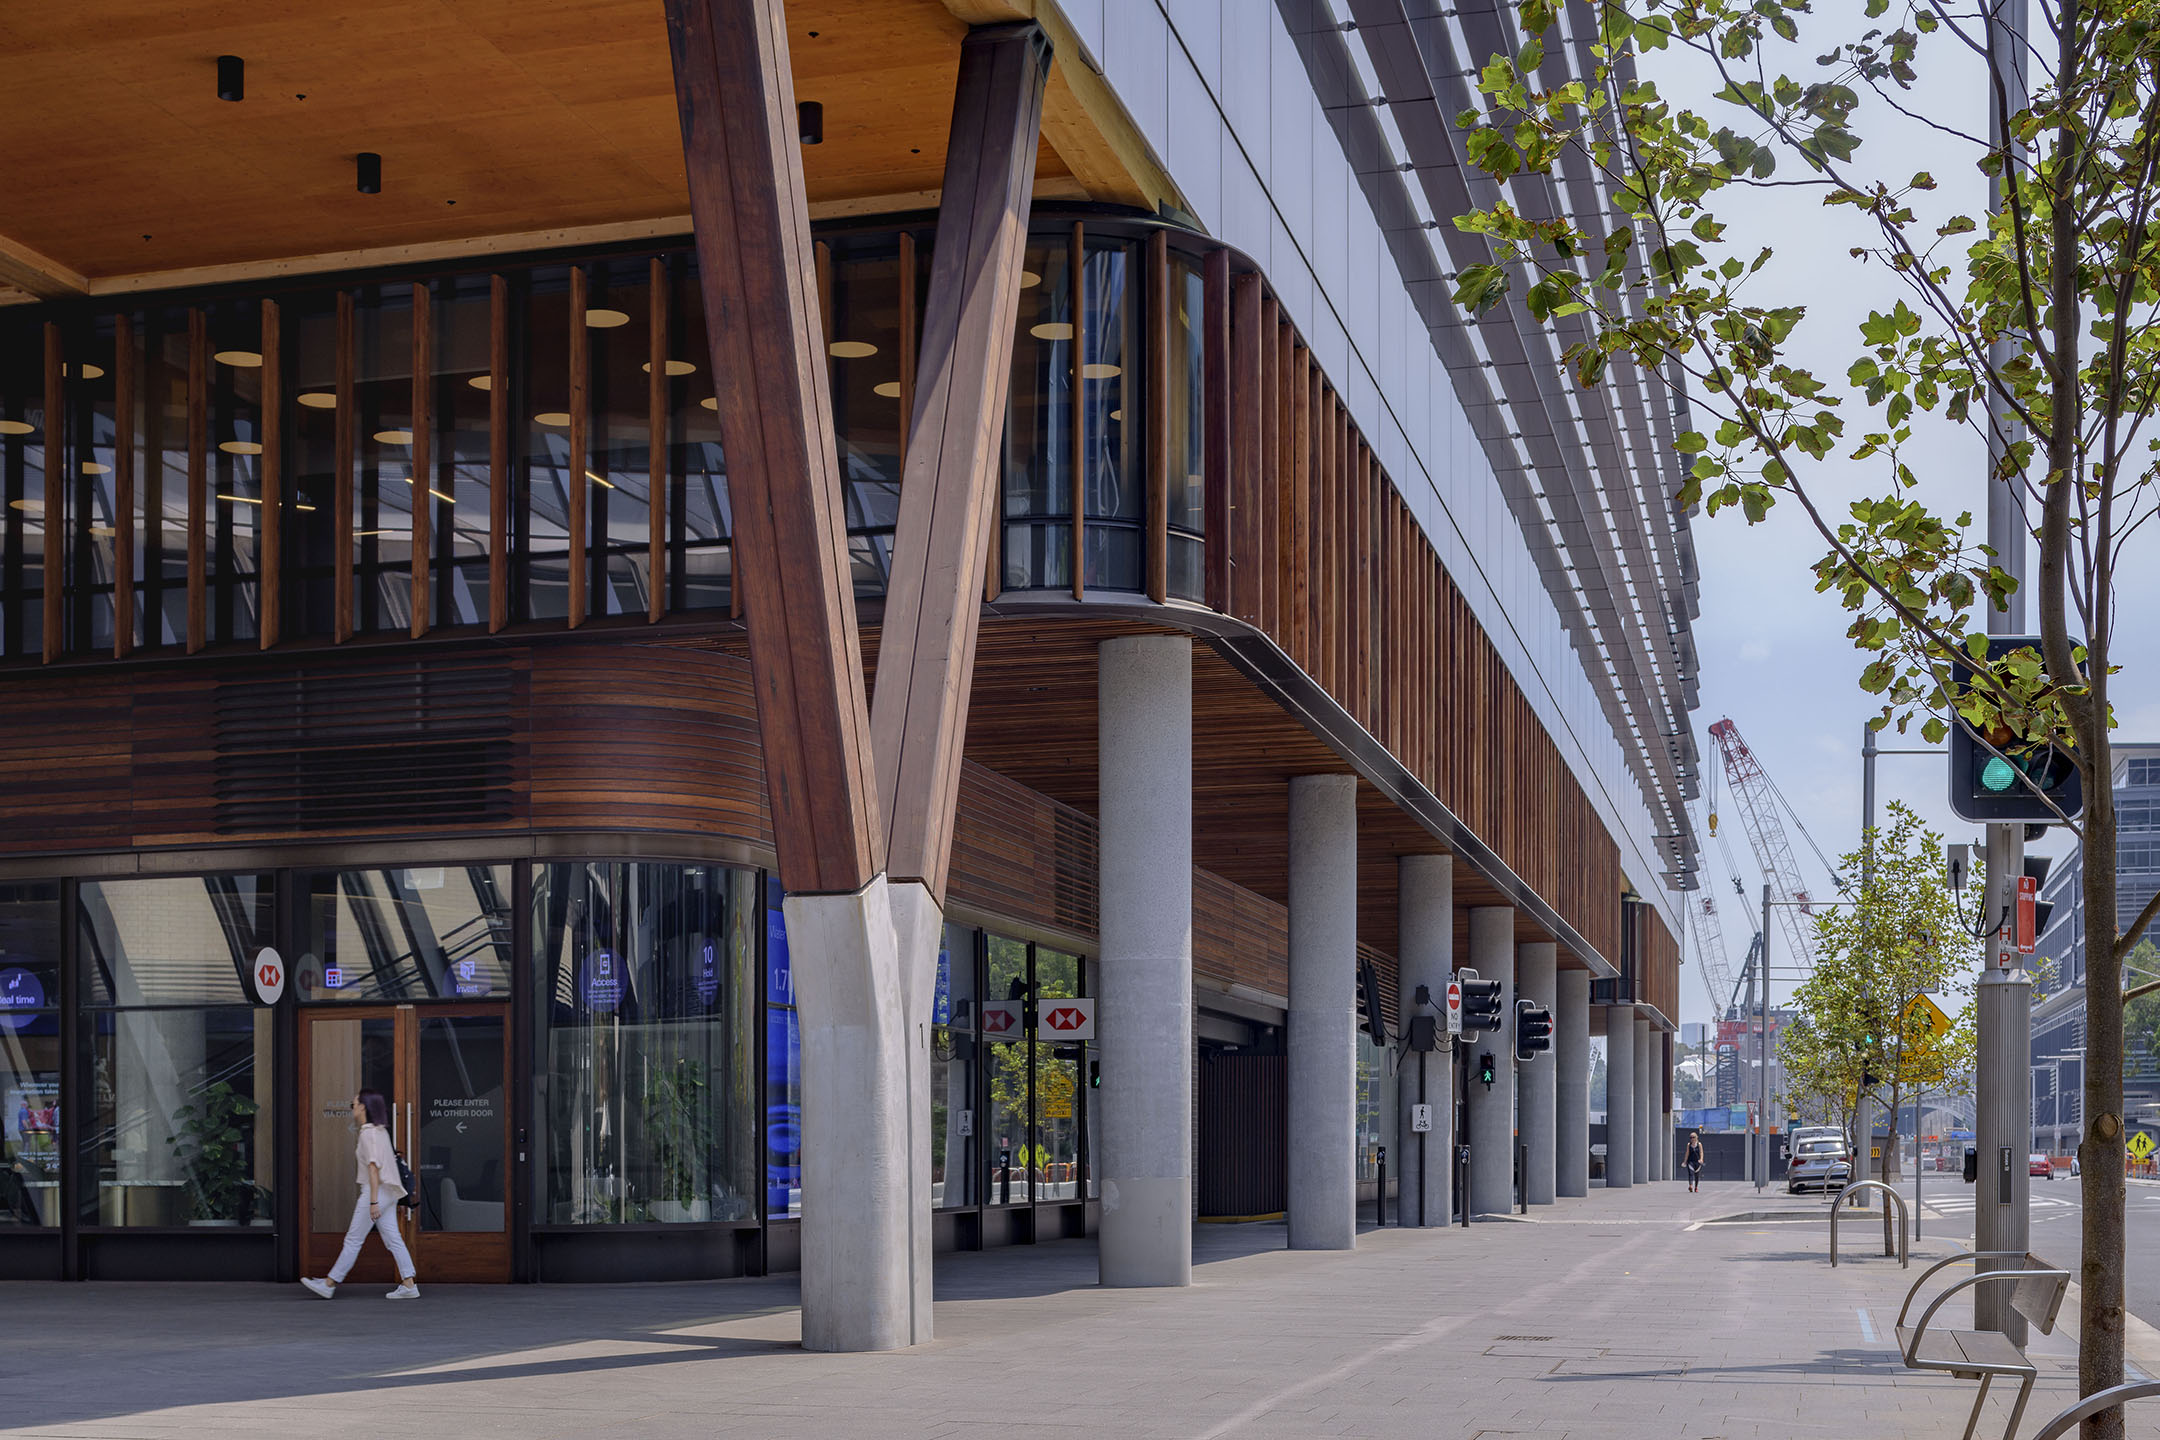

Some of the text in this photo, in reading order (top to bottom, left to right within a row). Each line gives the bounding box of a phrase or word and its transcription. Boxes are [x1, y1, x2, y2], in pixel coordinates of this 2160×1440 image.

[2000, 927, 2011, 941] H
[703, 945, 713, 964] 10
[2000, 953, 2011, 967] P
[592, 978, 618, 987] Access
[15, 995, 36, 1005] time
[1450, 1012, 1459, 1021] NO
[434, 1099, 490, 1107] PLEASE ENTER
[336, 1110, 353, 1118] OTH
